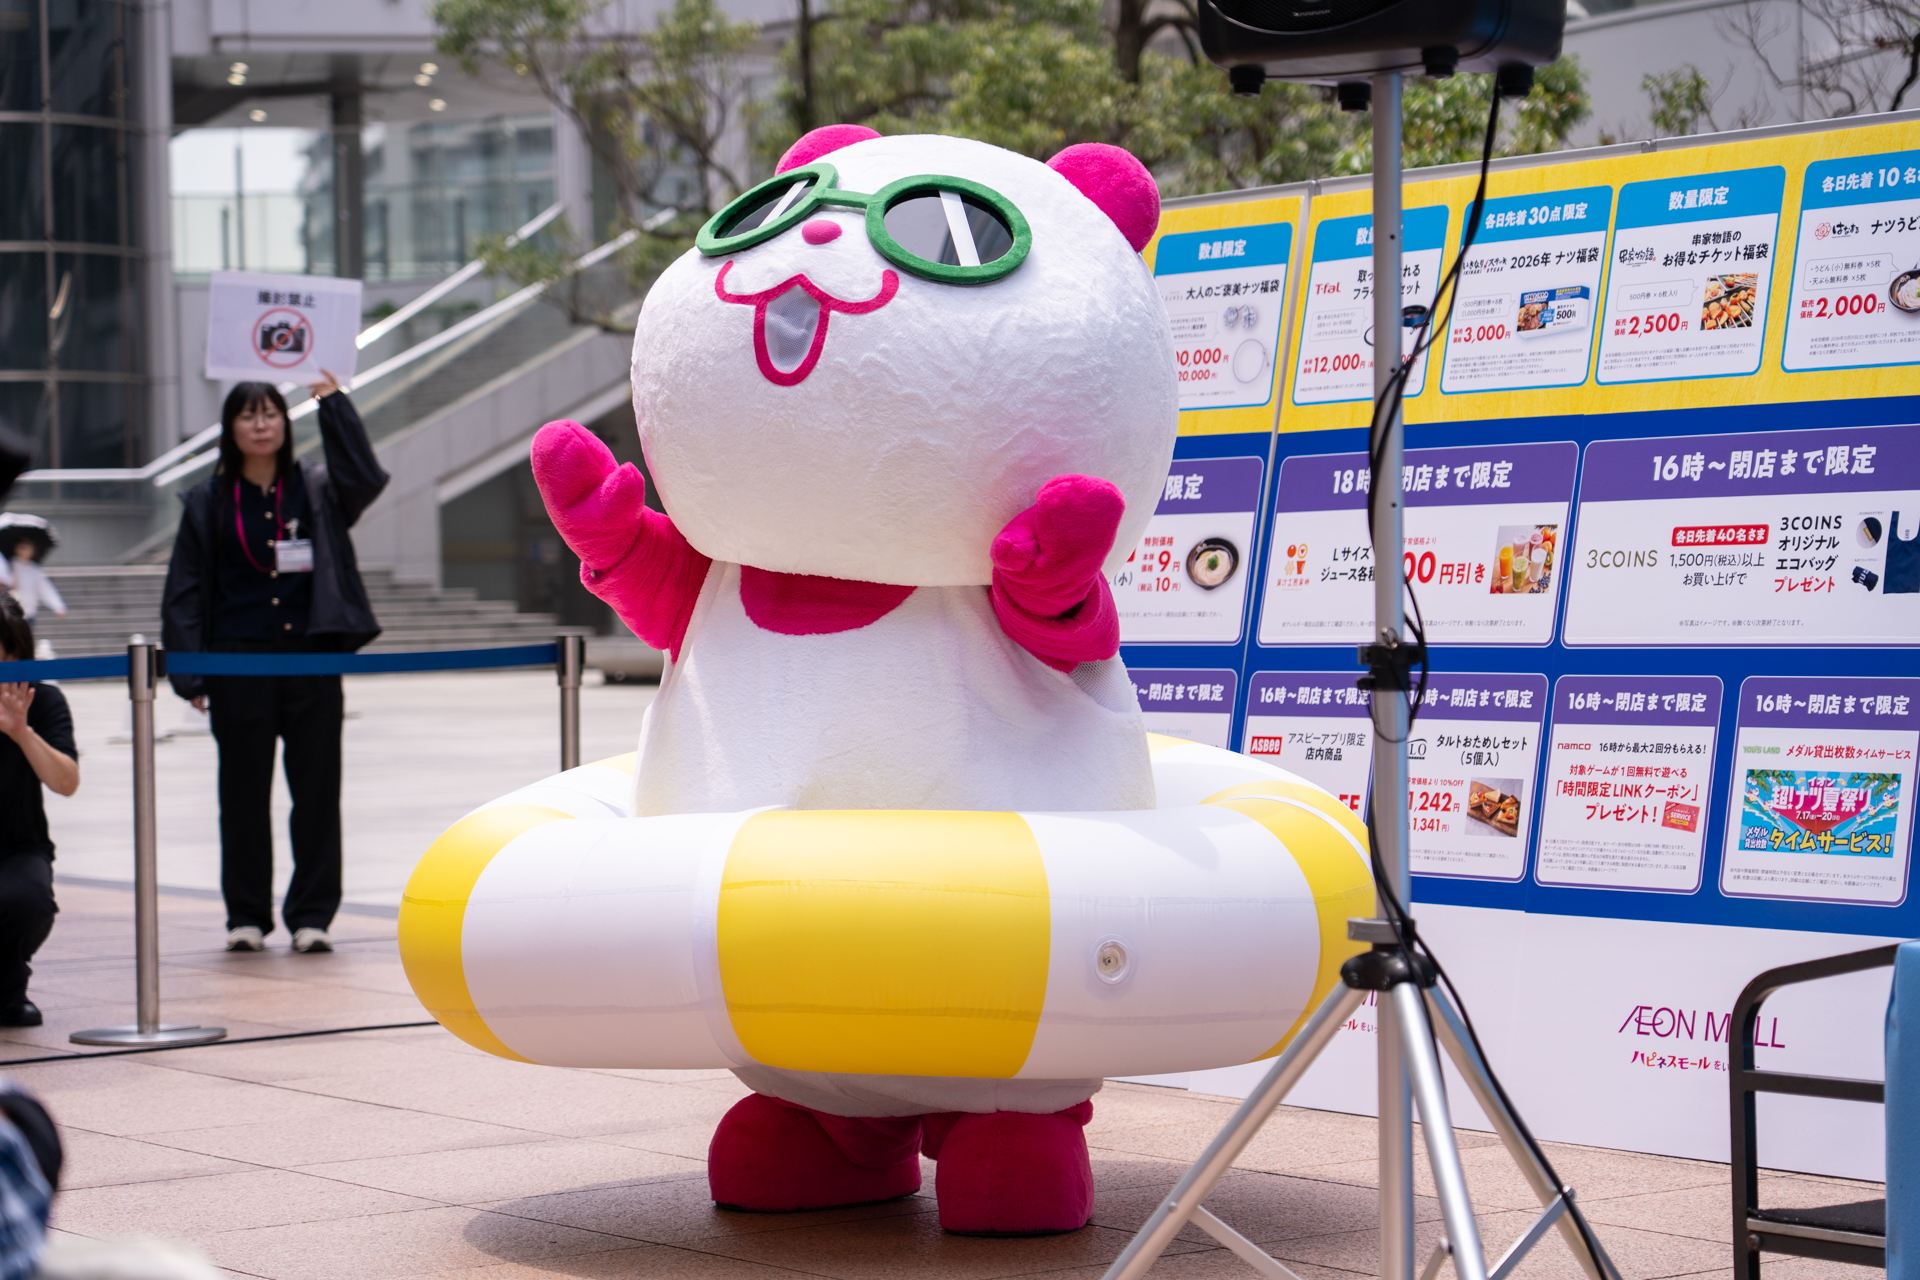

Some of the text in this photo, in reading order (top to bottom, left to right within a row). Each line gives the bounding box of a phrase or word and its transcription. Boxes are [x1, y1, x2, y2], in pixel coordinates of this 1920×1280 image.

[1822, 167, 1920, 193] 各日先着10名
[1668, 186, 1729, 211] 数量限定
[1871, 215, 1920, 235] ナツうど
[1692, 231, 1741, 246] 串家物語の
[1198, 239, 1246, 261] 数量限定
[1510, 246, 1600, 269] 2026年 ナツ福袋
[1663, 243, 1769, 267] お得なチケット福袋
[1186, 279, 1280, 300] 大人のご褒美ナツ福袋
[257, 290, 317, 309] 撮影禁止
[1801, 299, 1815, 308] 販売
[1615, 318, 1627, 327] 販売
[1800, 310, 1813, 319] 価格
[1628, 313, 1688, 338] 2,500円
[1463, 324, 1511, 344] 3,000円
[1164, 474, 1203, 501] 限定
[1780, 515, 1842, 531] 3COINS
[1144, 536, 1174, 547] 特別価格
[1675, 528, 1766, 544] 各日先着40名さま
[1778, 535, 1840, 551] オリジナル
[1587, 549, 1658, 569] 3COINS
[1776, 555, 1839, 571] エコバッグ
[1683, 572, 1748, 587] お買い上げで
[1774, 575, 1835, 593] プレゼント
[1288, 732, 1367, 746] アスビーアプリ限定
[1436, 734, 1527, 751] タルトおためしセット
[1557, 742, 1592, 751] namco
[1305, 747, 1342, 761] 店内商品
[1763, 746, 1781, 754] LAND
[1786, 745, 1911, 759] メダル貸出枚数タイムサービス
[1460, 751, 1499, 767] (5個入)
[1569, 764, 1688, 778] 対象ゲームが1回無料で遊べる
[1808, 776, 1836, 787] イオン
[1556, 780, 1699, 801] 「時間限定LINKクーポン」
[1745, 826, 1769, 837] メダル
[1744, 838, 1768, 849] 貸出枚数
[1704, 1011, 1786, 1048] MLL
